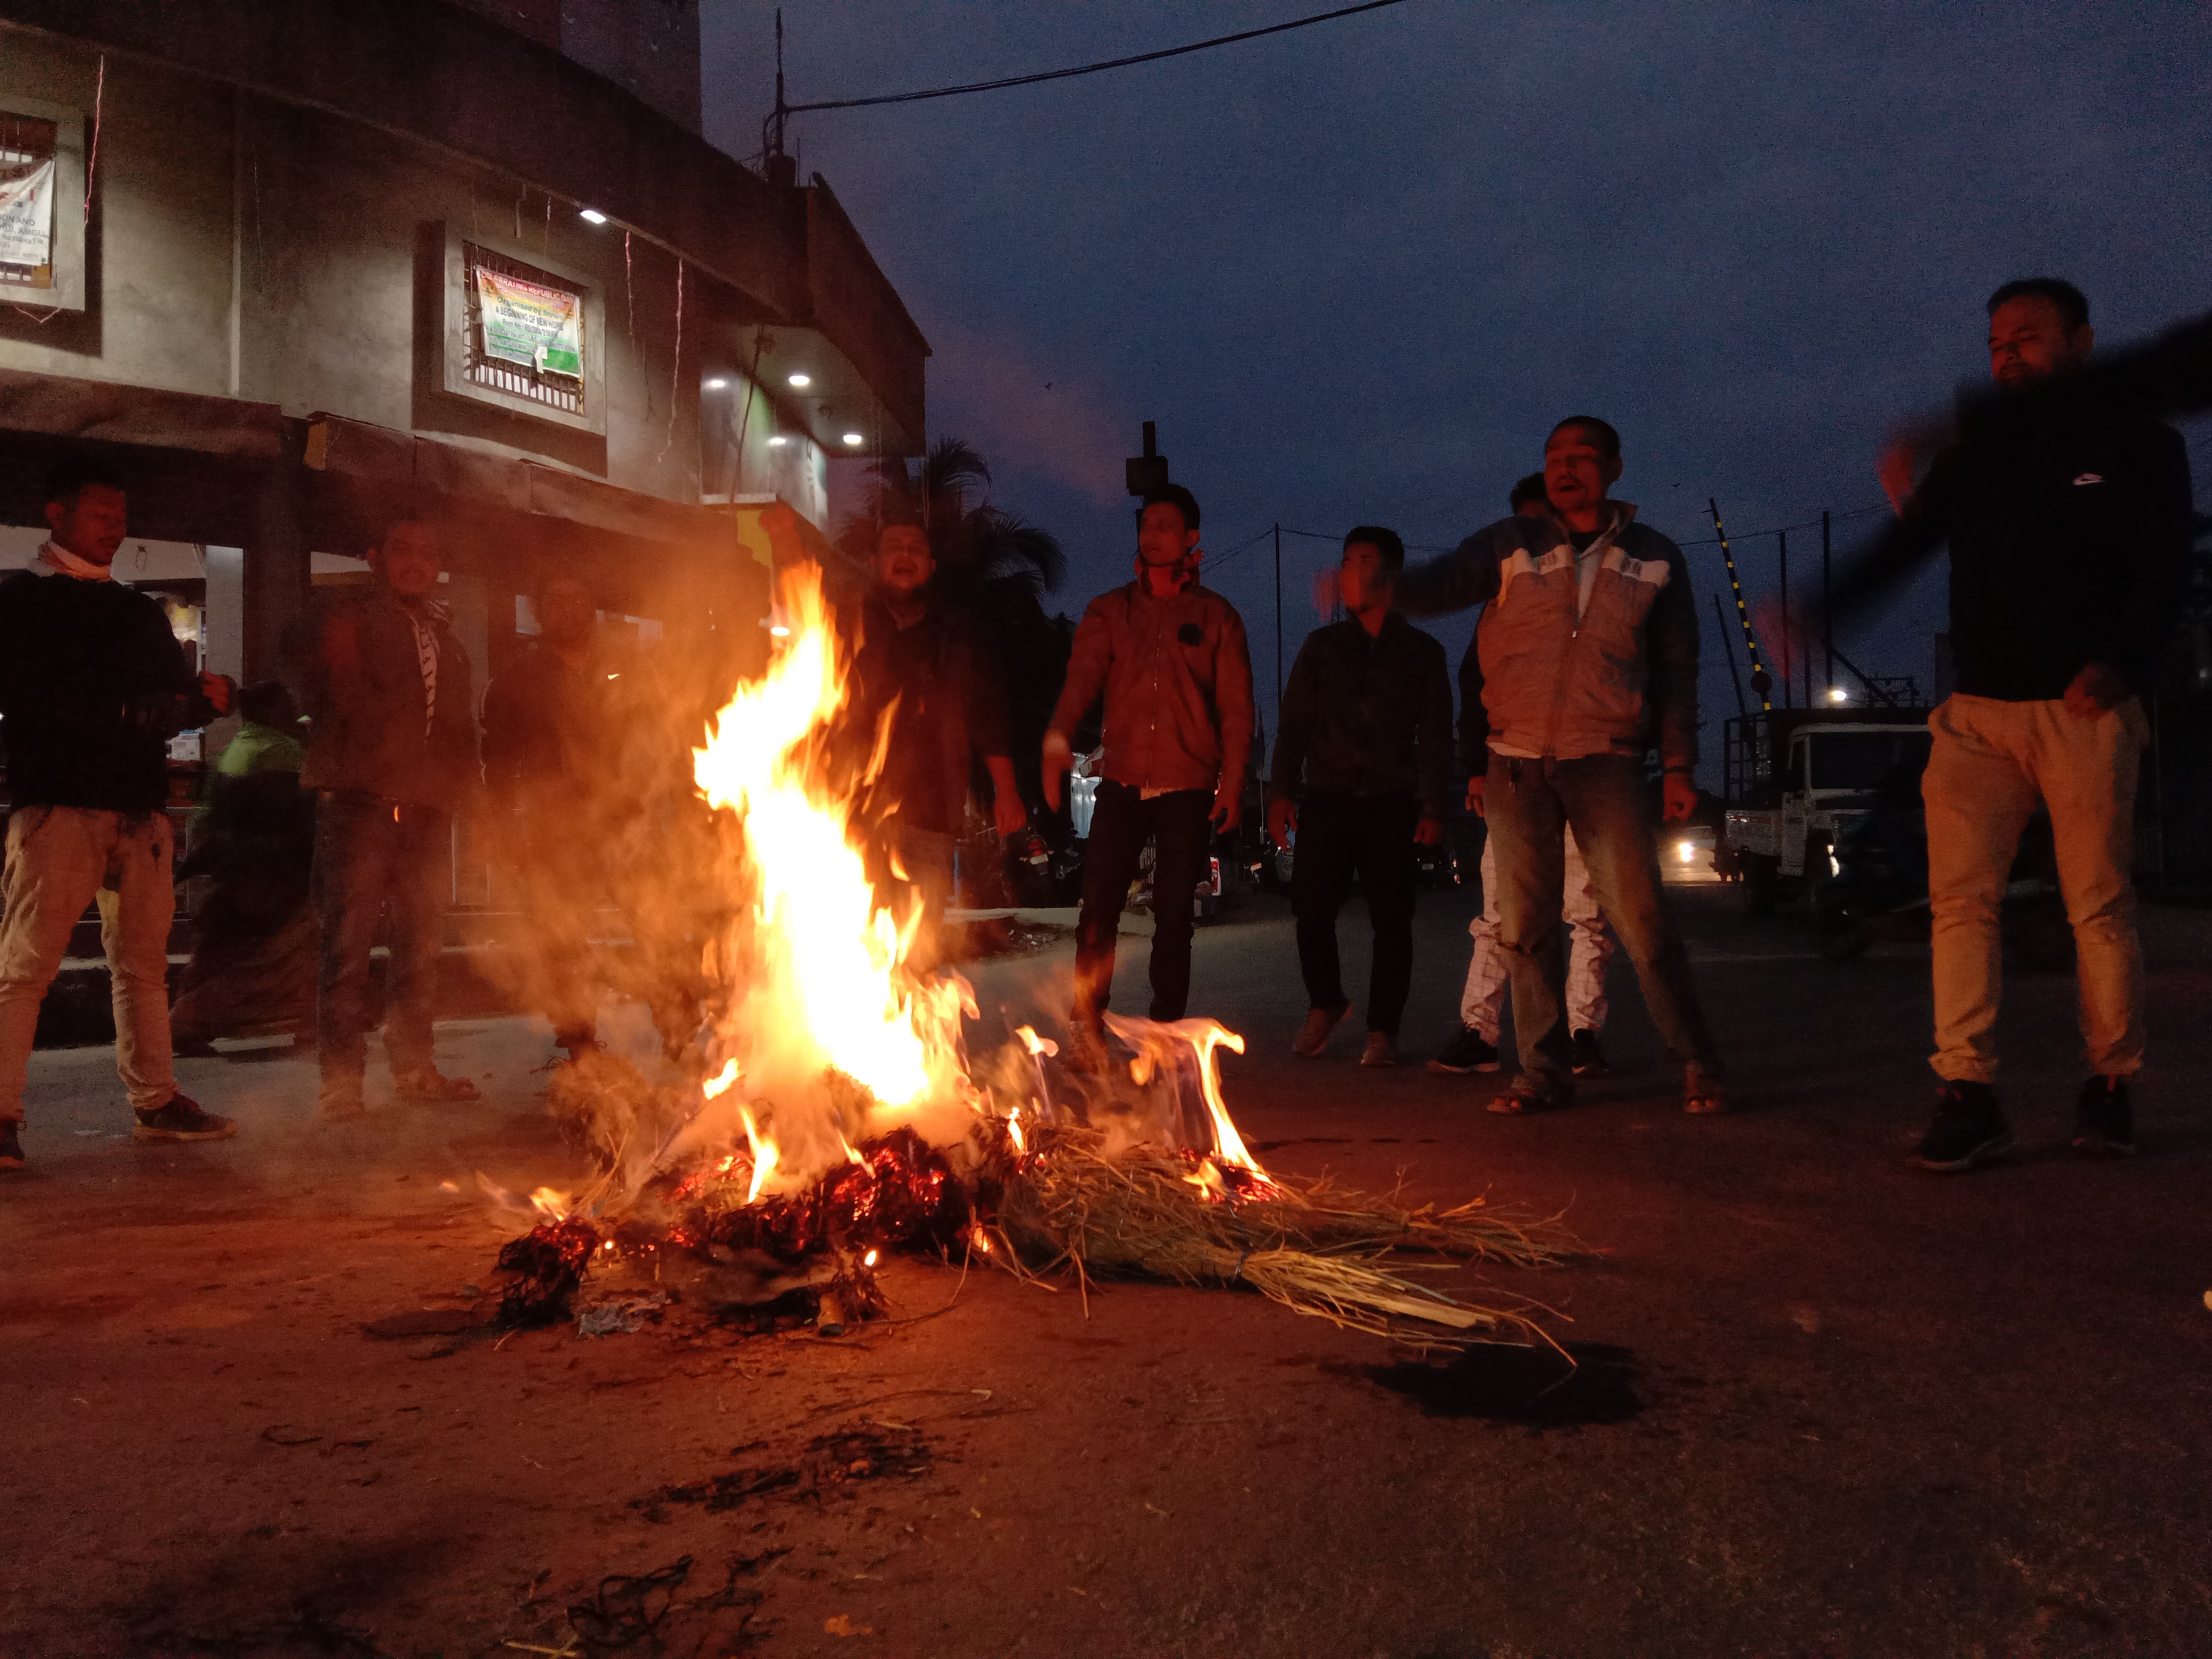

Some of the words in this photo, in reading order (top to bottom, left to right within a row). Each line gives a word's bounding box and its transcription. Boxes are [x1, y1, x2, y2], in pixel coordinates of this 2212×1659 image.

[17, 216, 35, 227] AND
[528, 287, 560, 300] REPUBLIC
[497, 296, 532, 312] Organised
[533, 307, 541, 316] by
[500, 306, 528, 321] BEGINNING
[529, 315, 535, 323] OF
[537, 316, 547, 327] NEW
